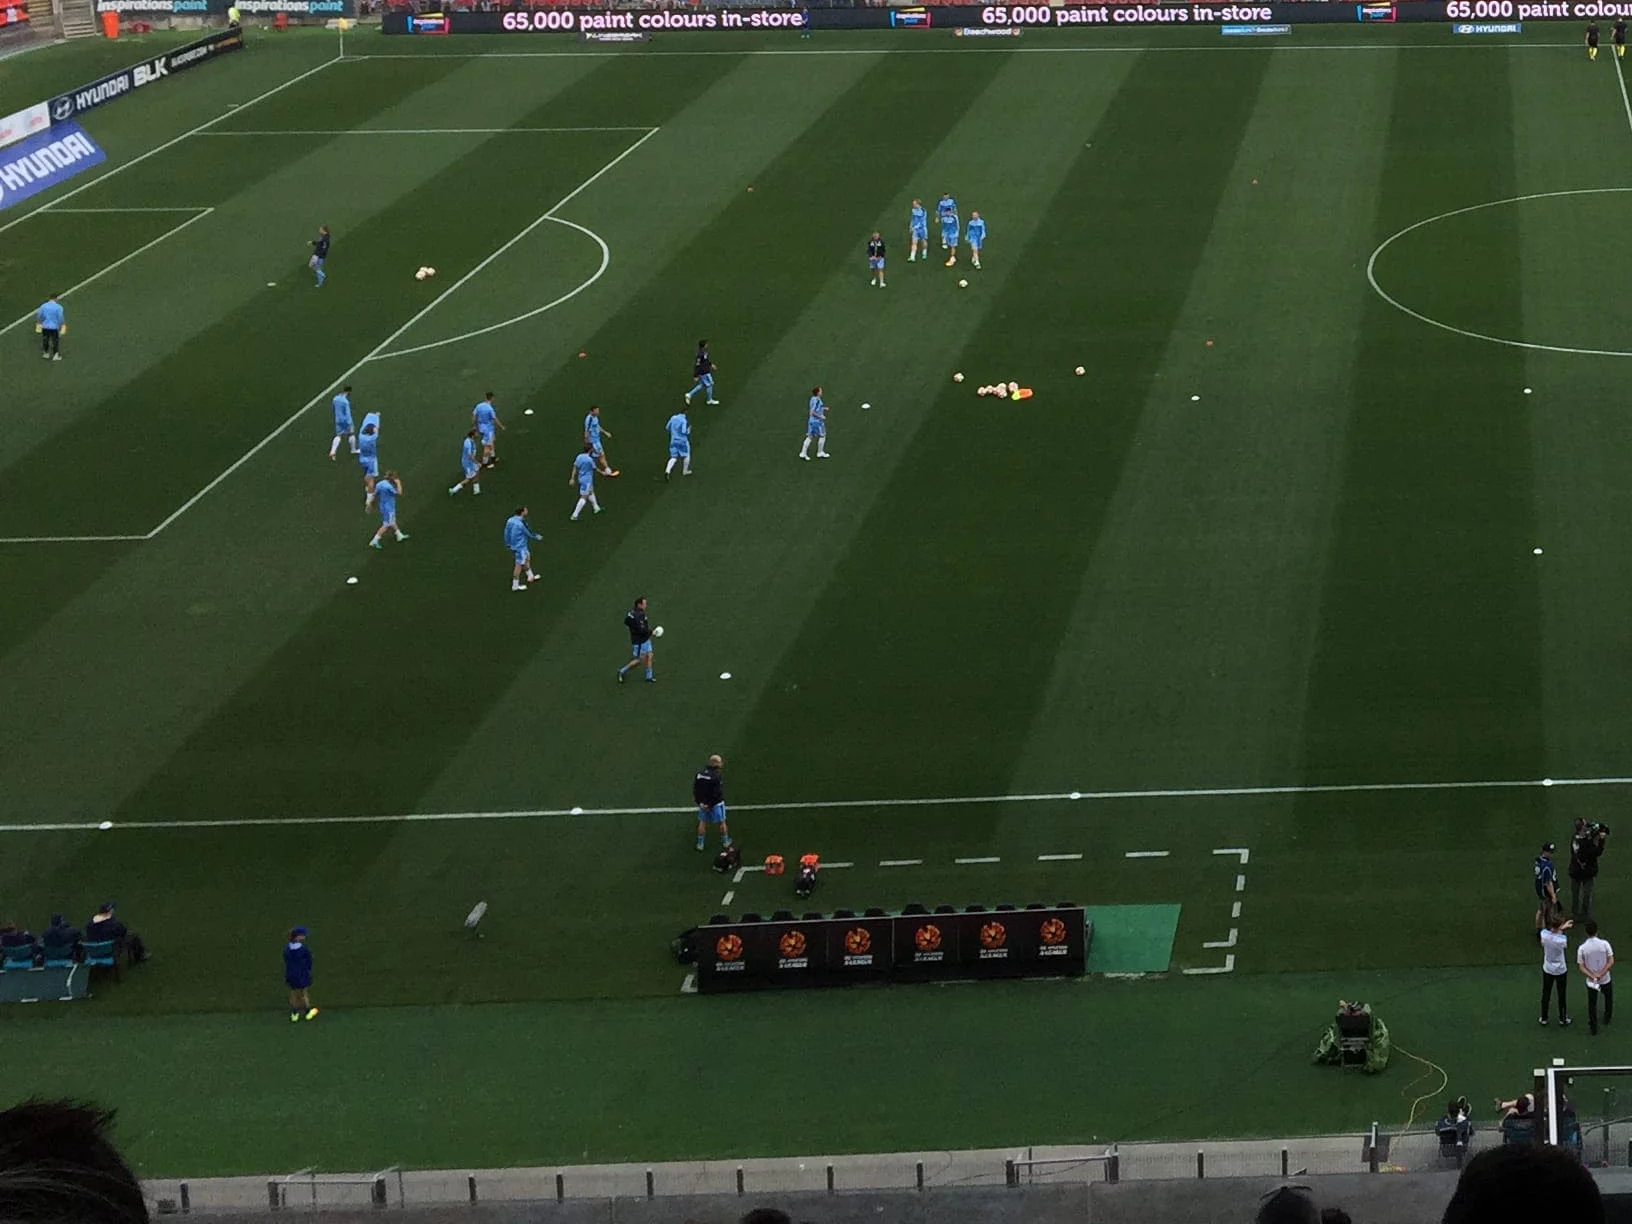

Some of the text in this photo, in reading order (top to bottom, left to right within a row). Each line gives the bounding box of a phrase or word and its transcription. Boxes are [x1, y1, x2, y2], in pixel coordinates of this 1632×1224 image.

[503, 10, 802, 32] 65,000 paint colours in-store
[982, 4, 1272, 26] 65,000 paint colours in-store
[1446, 1, 1513, 19] 65,000
[1518, 0, 1569, 20] paint
[1475, 24, 1516, 33] HYUNDAI
[132, 56, 168, 87] BLK
[75, 74, 129, 111] HYUNDAI
[1, 131, 96, 191] HYUNDAI
